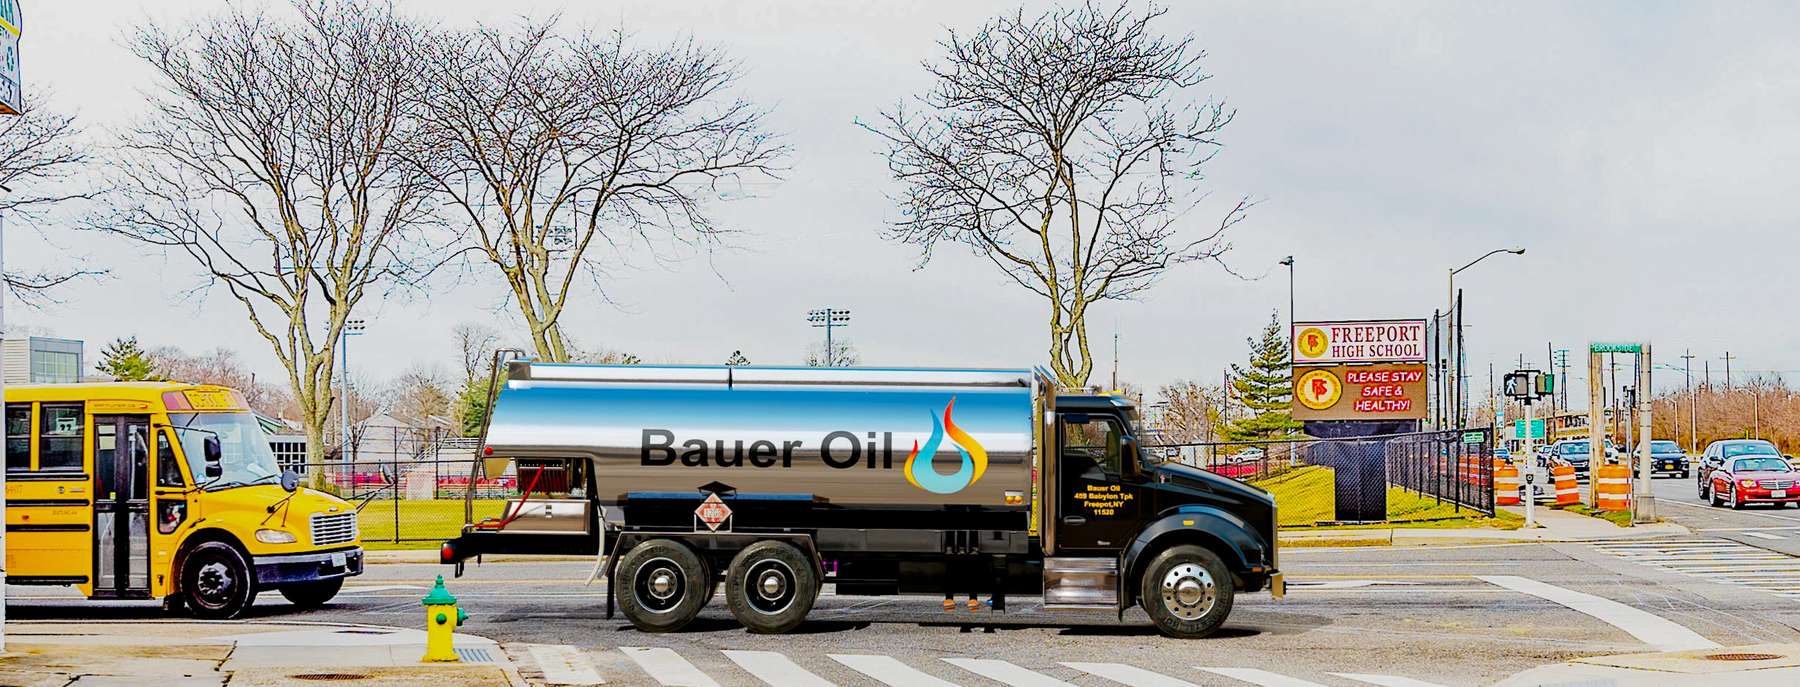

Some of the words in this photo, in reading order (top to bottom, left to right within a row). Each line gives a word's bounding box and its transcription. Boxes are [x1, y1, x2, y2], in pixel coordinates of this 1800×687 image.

[1331, 326, 1420, 342] FREEPORT
[1332, 345, 1363, 357] HIGH
[1369, 344, 1420, 357] SCHOOL
[1347, 372, 1389, 382] PLEASE
[1391, 371, 1422, 381] STAY
[1362, 386, 1393, 396] SAFE
[1394, 386, 1403, 395] &
[1355, 400, 1410, 410] HEALTHY!
[640, 428, 803, 468] Bauer
[820, 430, 893, 469] Oil
